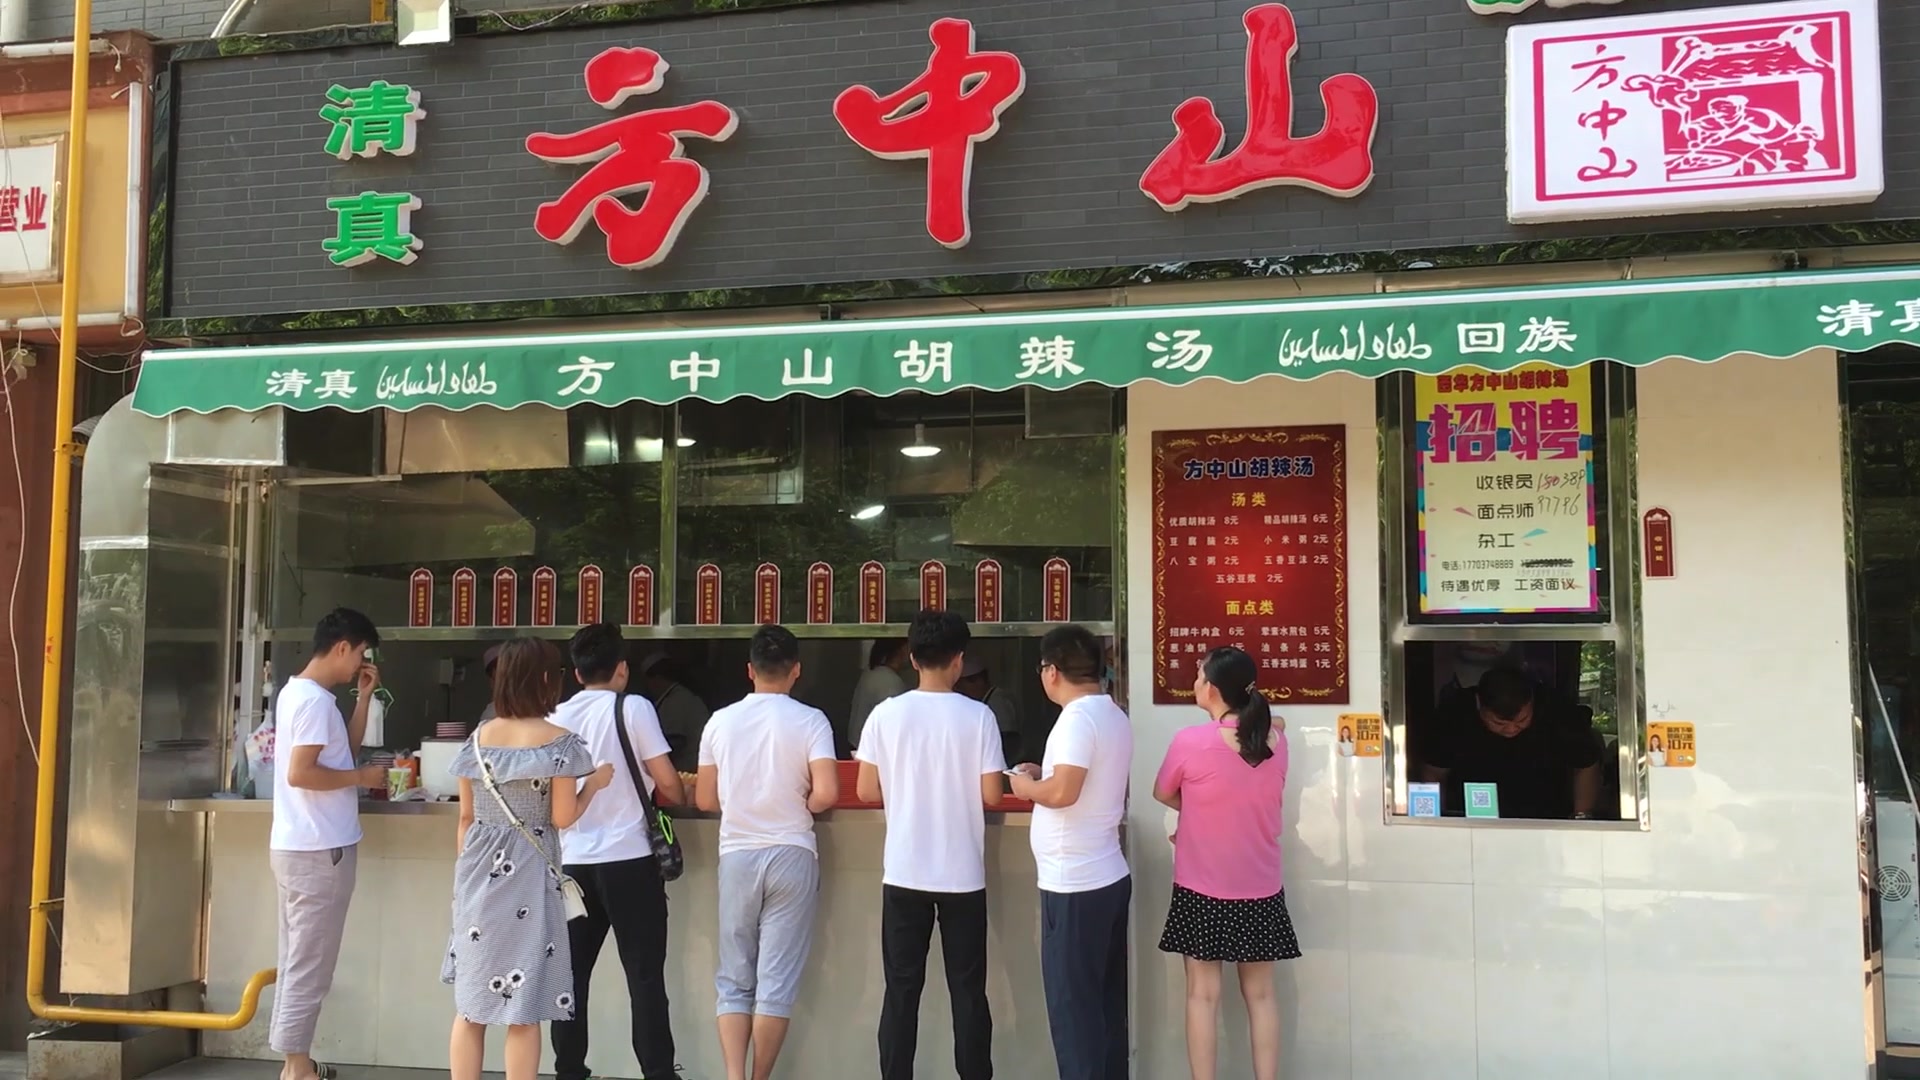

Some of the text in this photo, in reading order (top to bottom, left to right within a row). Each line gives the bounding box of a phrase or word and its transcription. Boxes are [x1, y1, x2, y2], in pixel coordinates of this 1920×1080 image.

[1571, 44, 1638, 182] 方中山
[525, 3, 1378, 271] 方中山
[318, 80, 425, 267] 清真
[266, 368, 358, 400] 清真
[557, 329, 1213, 396] 方中山胡辣汤
[1456, 316, 1578, 354] 回族
[1427, 399, 1581, 463] 招聘
[1184, 456, 1315, 480] 方中山胡辣汤
[1476, 474, 1534, 490] 收银员
[1231, 492, 1267, 507] 汤类
[1312, 513, 1329, 523] 6元
[1477, 503, 1535, 520] 面点师
[1223, 515, 1239, 525] 8元
[1223, 535, 1239, 545] 2元
[1312, 533, 1329, 544] 2元
[1477, 533, 1516, 549] 杂工
[1223, 555, 1239, 565] 2元
[1313, 554, 1329, 564] 2元
[1266, 573, 1284, 583] 2元
[1441, 578, 1576, 592] 待遇优厚 工资面议
[1225, 599, 1275, 616] 面点类
[1228, 626, 1245, 636] 6元
[1313, 625, 1331, 636] 5元
[1313, 642, 1331, 652] 3元
[1315, 658, 1331, 668] 1元
